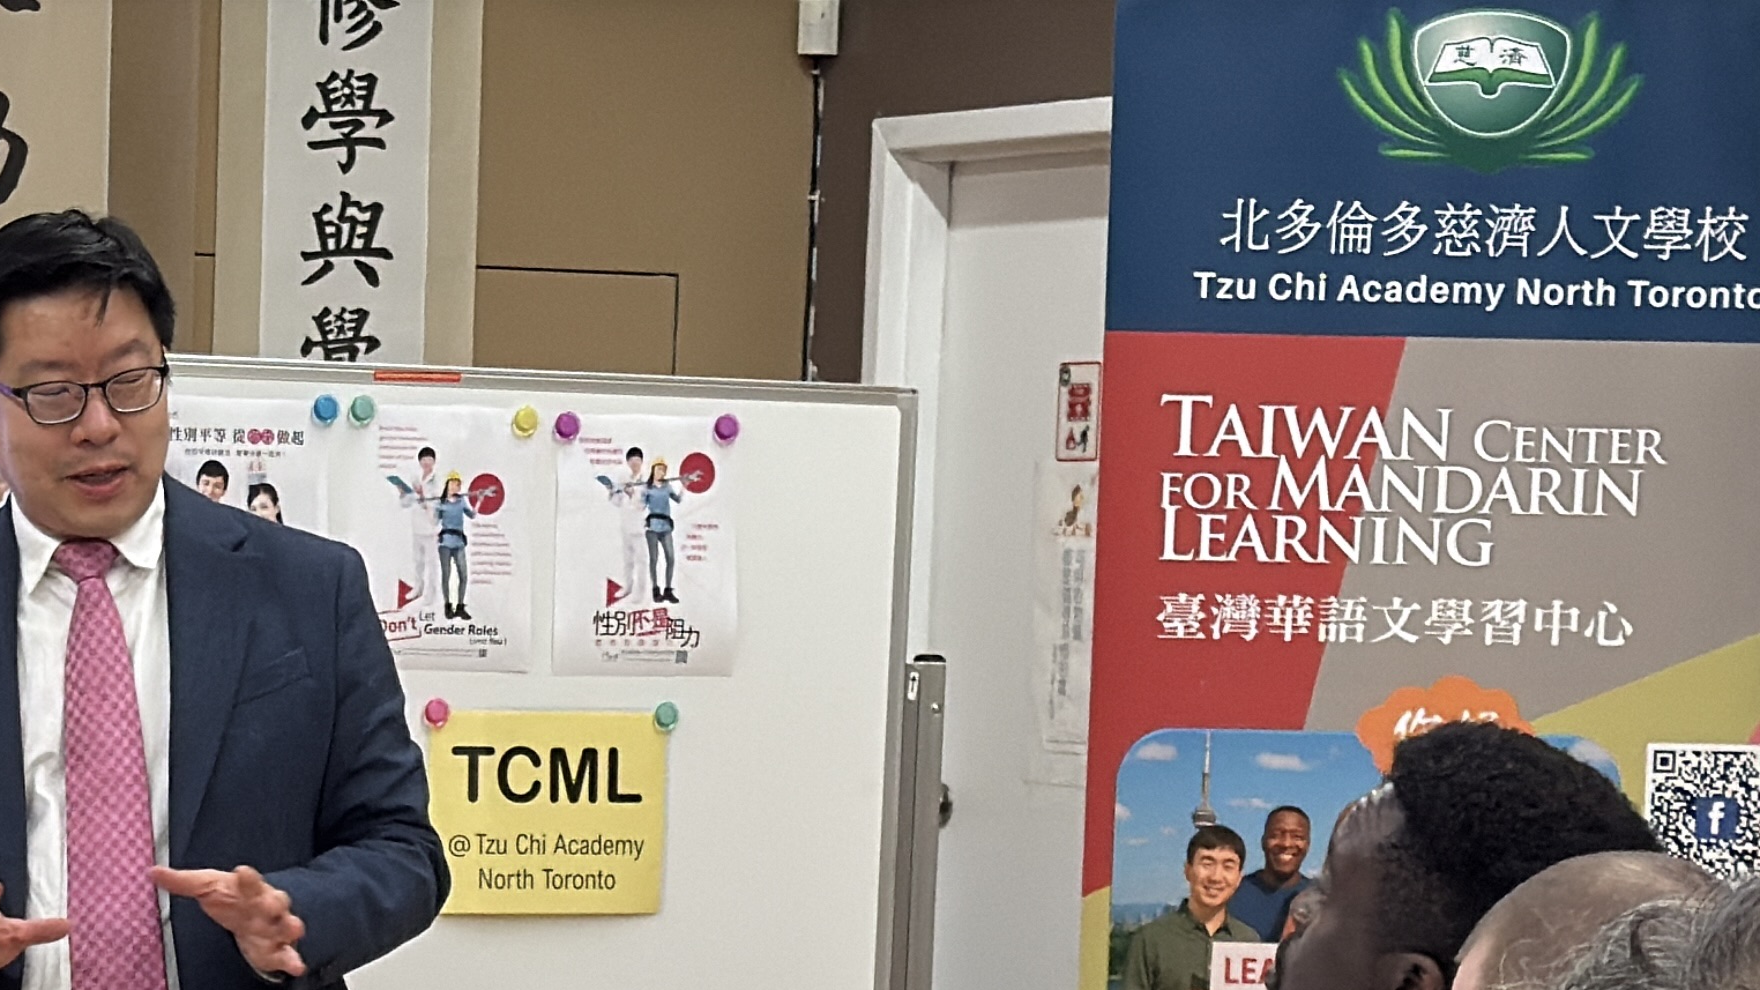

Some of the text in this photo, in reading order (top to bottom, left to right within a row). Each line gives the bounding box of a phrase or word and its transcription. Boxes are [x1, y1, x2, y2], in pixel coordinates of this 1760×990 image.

[1219, 197, 1749, 263] 北多倫多慈濟人文學校
[1193, 271, 1256, 300] Tzu
[1268, 271, 1327, 301] Chi
[1337, 275, 1505, 312] Academy
[1516, 277, 1616, 307] North
[1160, 393, 1667, 465] TAIWAN CENTER
[1161, 455, 1645, 517] FOR MANDARIN
[1159, 505, 1494, 566] LEARNING
[424, 624, 499, 637] Gender Roles
[1156, 592, 1634, 647] 臺灣華語文學習中心
[451, 745, 643, 804] TCML
[448, 833, 645, 862] @ Tzu Chi Academy
[478, 867, 617, 891] North Toronto
